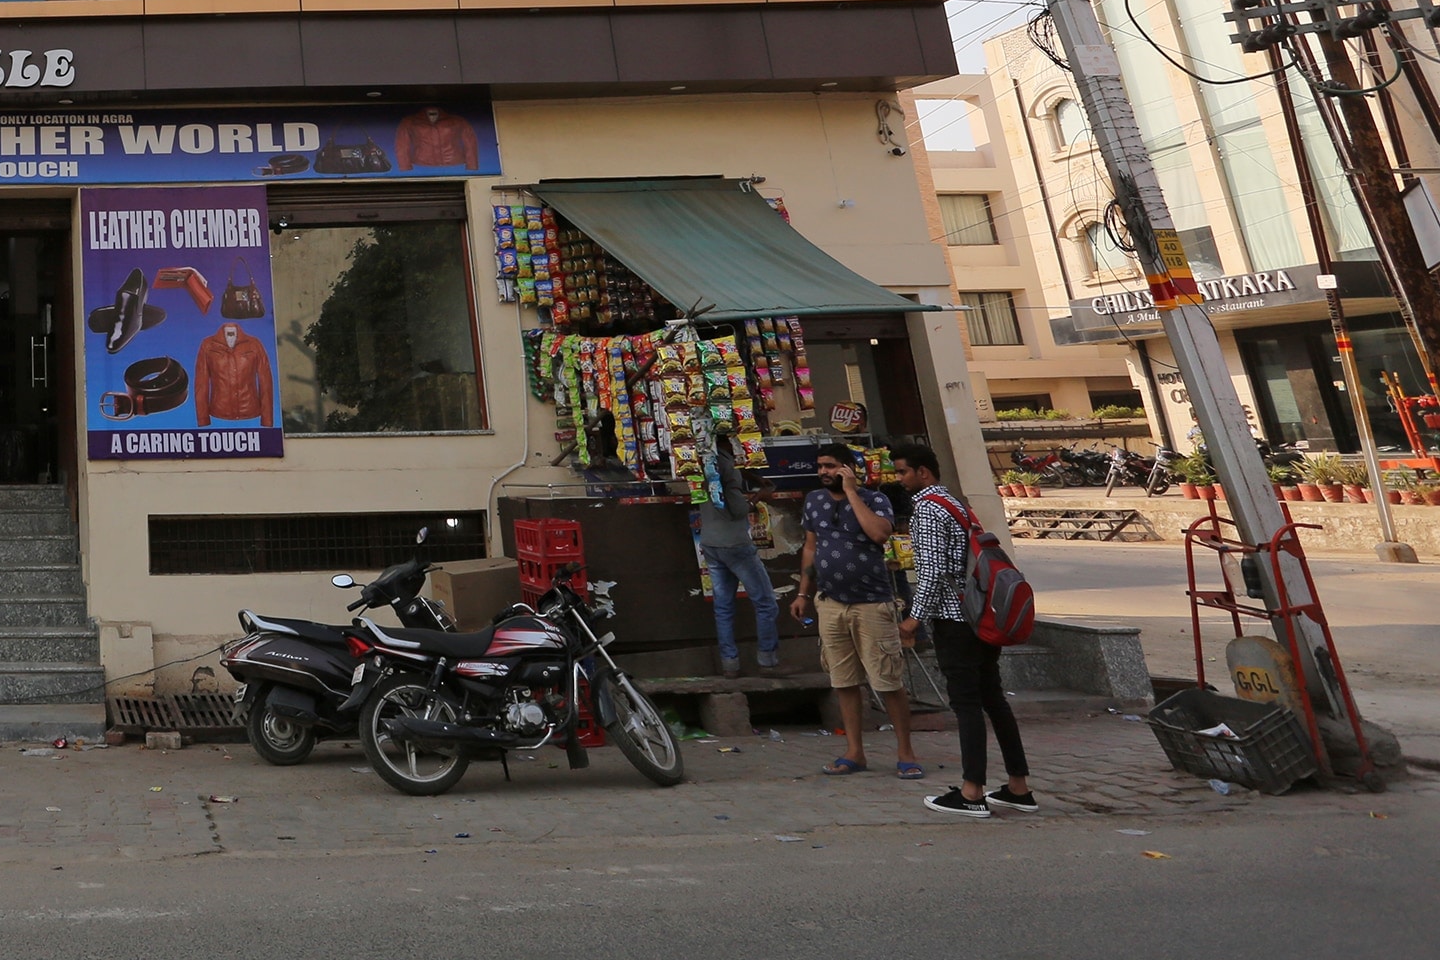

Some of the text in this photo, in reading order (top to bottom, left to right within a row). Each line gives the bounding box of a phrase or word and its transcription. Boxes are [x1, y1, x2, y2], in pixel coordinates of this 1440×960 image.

[0, 115, 27, 125] ONLY
[29, 114, 85, 124] LOCATION
[87, 114, 100, 124] IN
[102, 114, 133, 123] AGRA
[118, 122, 320, 155] WORLD
[89, 209, 262, 250] LEATHER CHEMBER
[1163, 242, 1177, 251] 40
[1091, 270, 1297, 315] CHILLY ATKARA
[1126, 313, 1135, 325] A
[1137, 310, 1161, 322] Mul
[1157, 371, 1182, 385] HOT
[830, 405, 862, 426] Lay's
[111, 431, 261, 453] A CARING TOUCH
